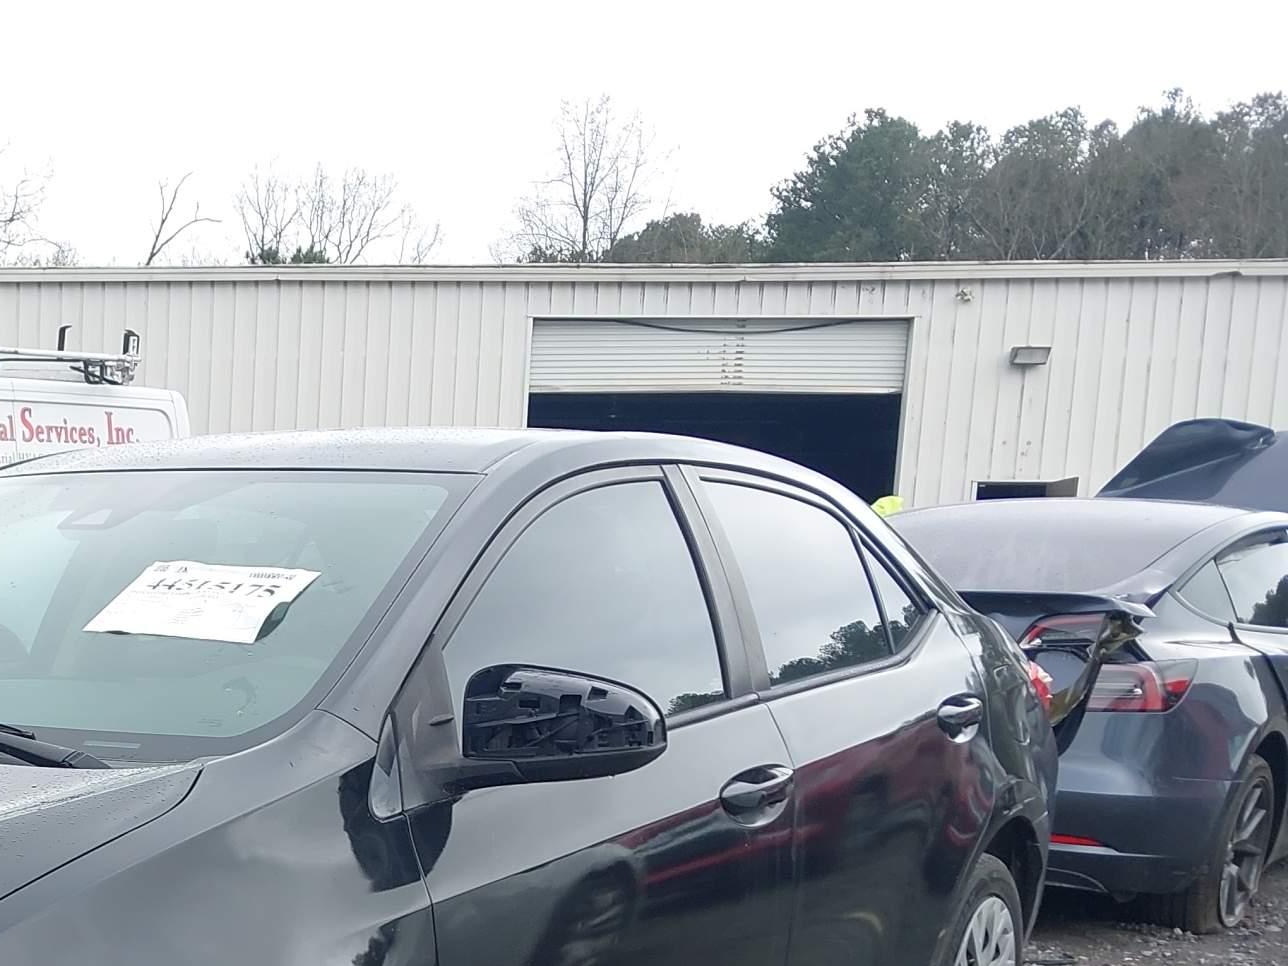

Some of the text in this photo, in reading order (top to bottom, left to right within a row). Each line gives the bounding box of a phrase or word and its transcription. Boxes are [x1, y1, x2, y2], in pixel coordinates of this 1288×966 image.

[20, 406, 101, 448] Services,
[104, 411, 140, 446] Inc.
[146, 577, 282, 598] 44515175
